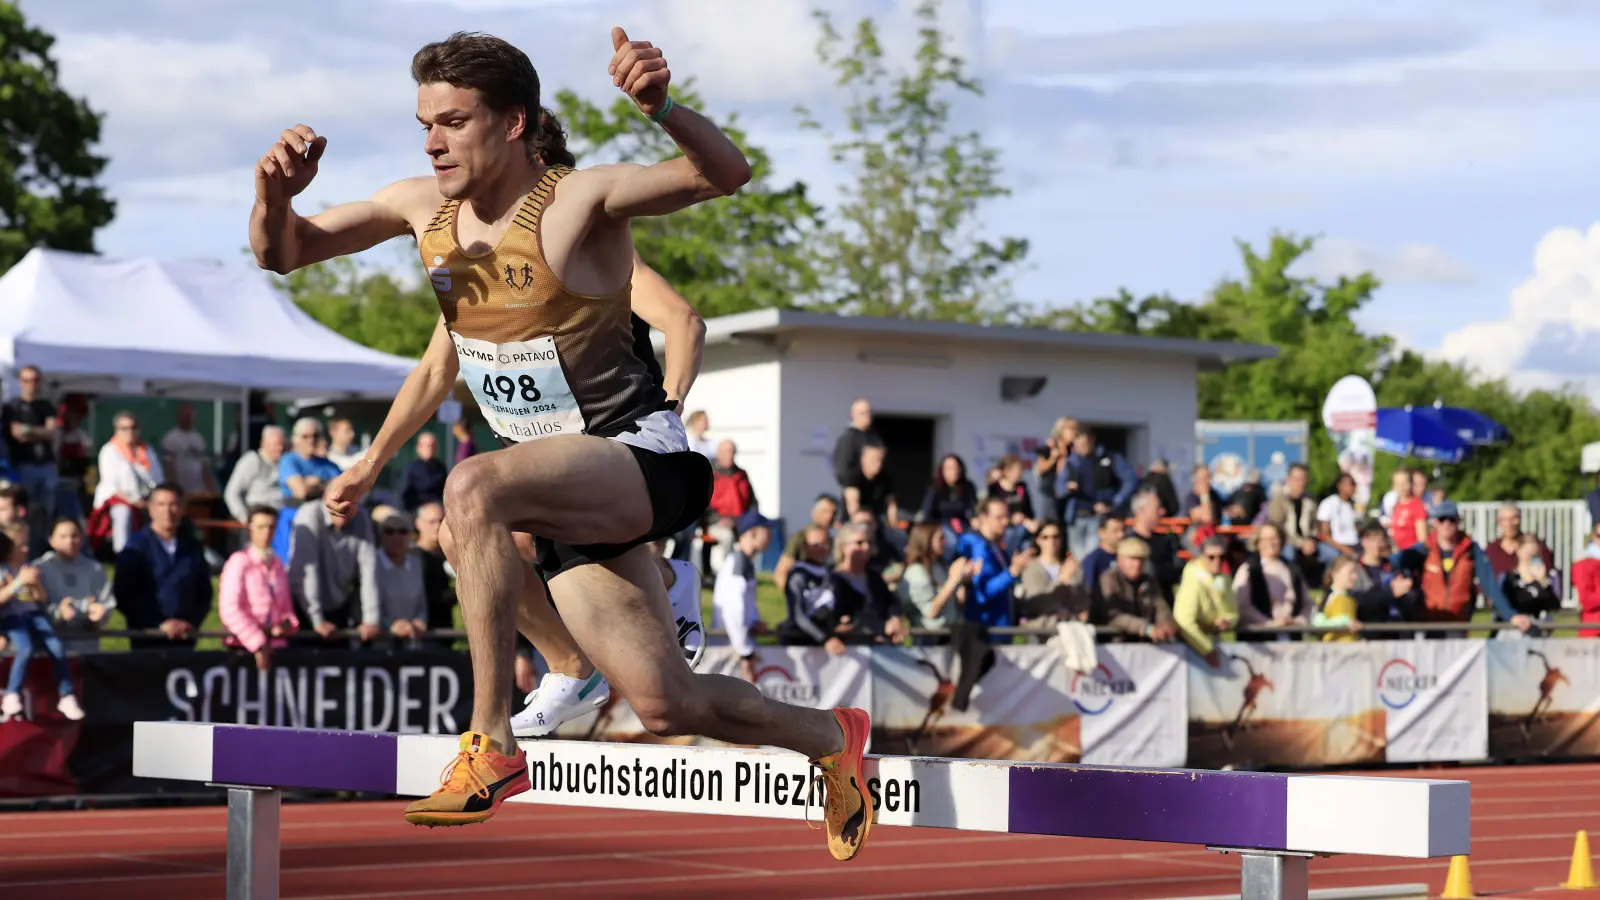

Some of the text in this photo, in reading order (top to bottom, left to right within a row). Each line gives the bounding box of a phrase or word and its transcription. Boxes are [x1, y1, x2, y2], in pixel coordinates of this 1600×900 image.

[513, 349, 555, 363] PATAVO
[482, 373, 541, 403] 498
[533, 403, 557, 413] 2024
[509, 419, 562, 437] thallos
[166, 666, 460, 734] SCHNEIDER
[523, 751, 920, 813] nbuchstadion Pliezhsen
